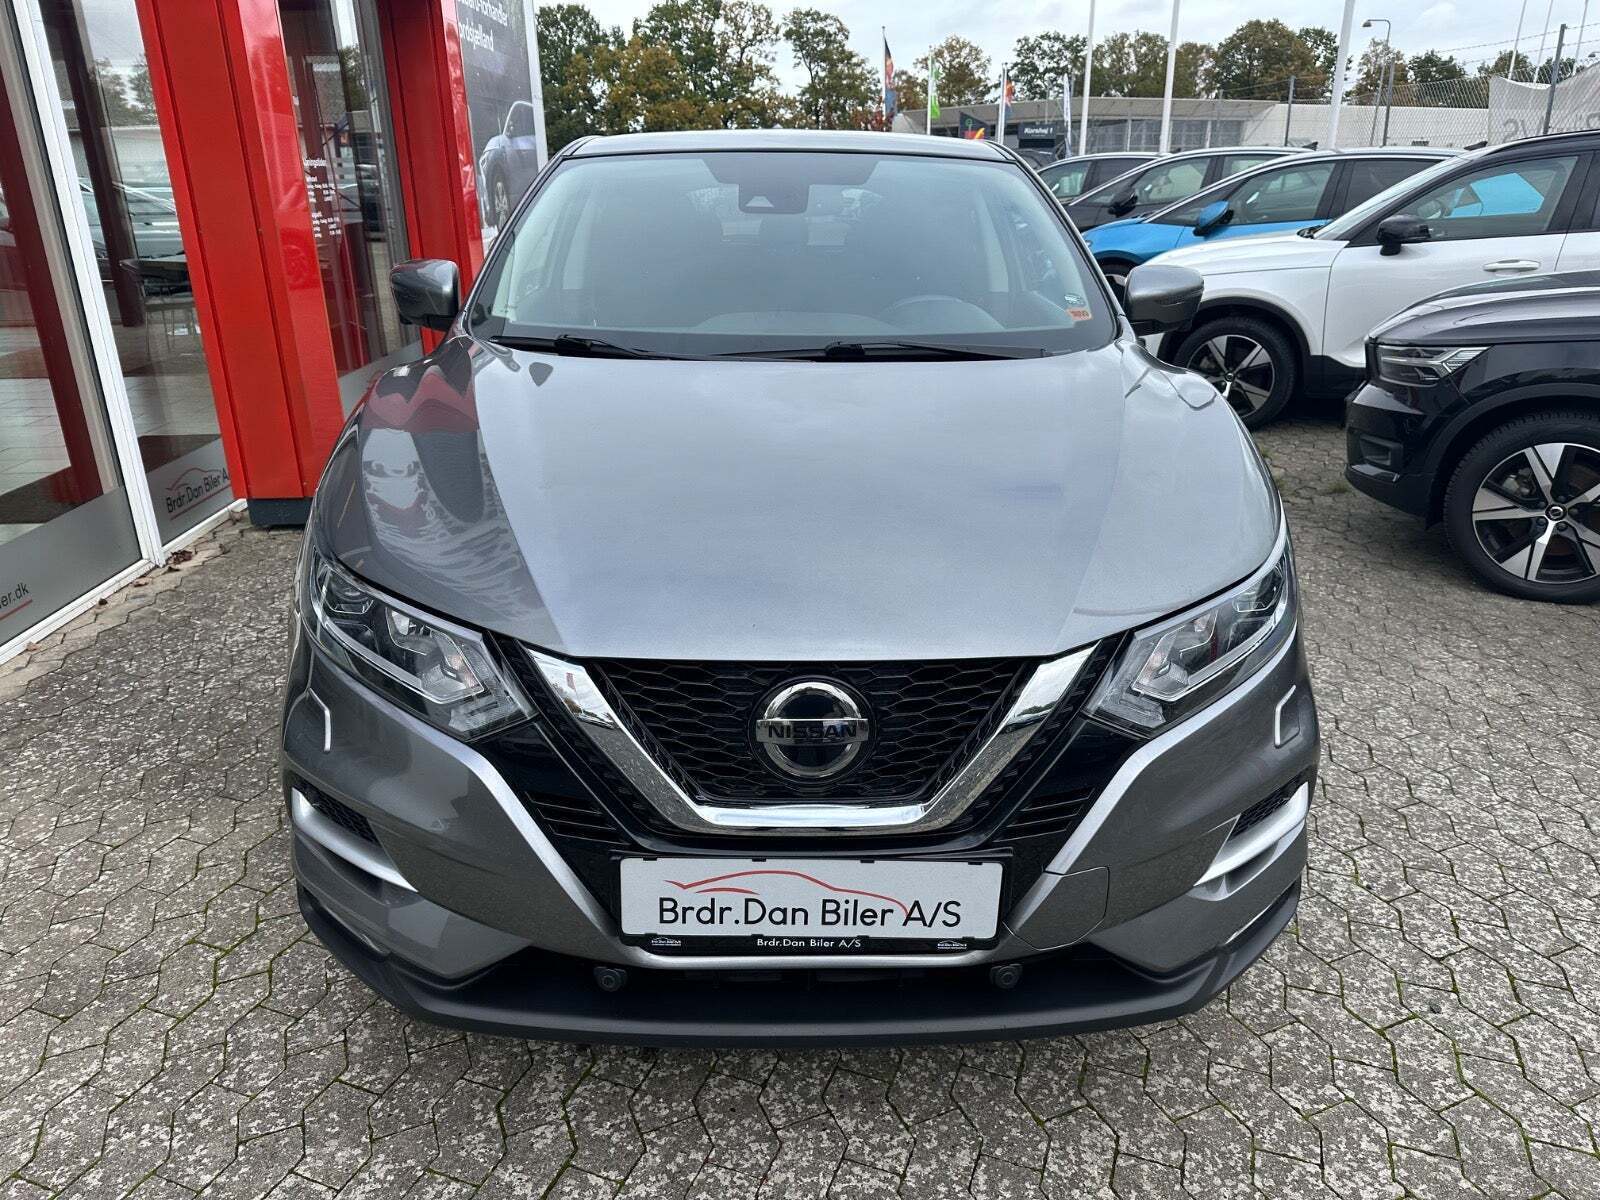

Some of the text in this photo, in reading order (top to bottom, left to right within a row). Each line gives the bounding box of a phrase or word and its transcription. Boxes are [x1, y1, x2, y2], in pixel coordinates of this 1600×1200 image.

[457, 17, 495, 52] ordsjælland
[166, 486, 203, 513] Brdr.Dan
[203, 474, 221, 492] Biler
[0, 582, 29, 608] er.dk
[768, 725, 857, 738] NISSAN
[659, 897, 962, 928] Brdr.Dan Biler A/S
[757, 938, 862, 948] Brdr.Dan Biler A/S
